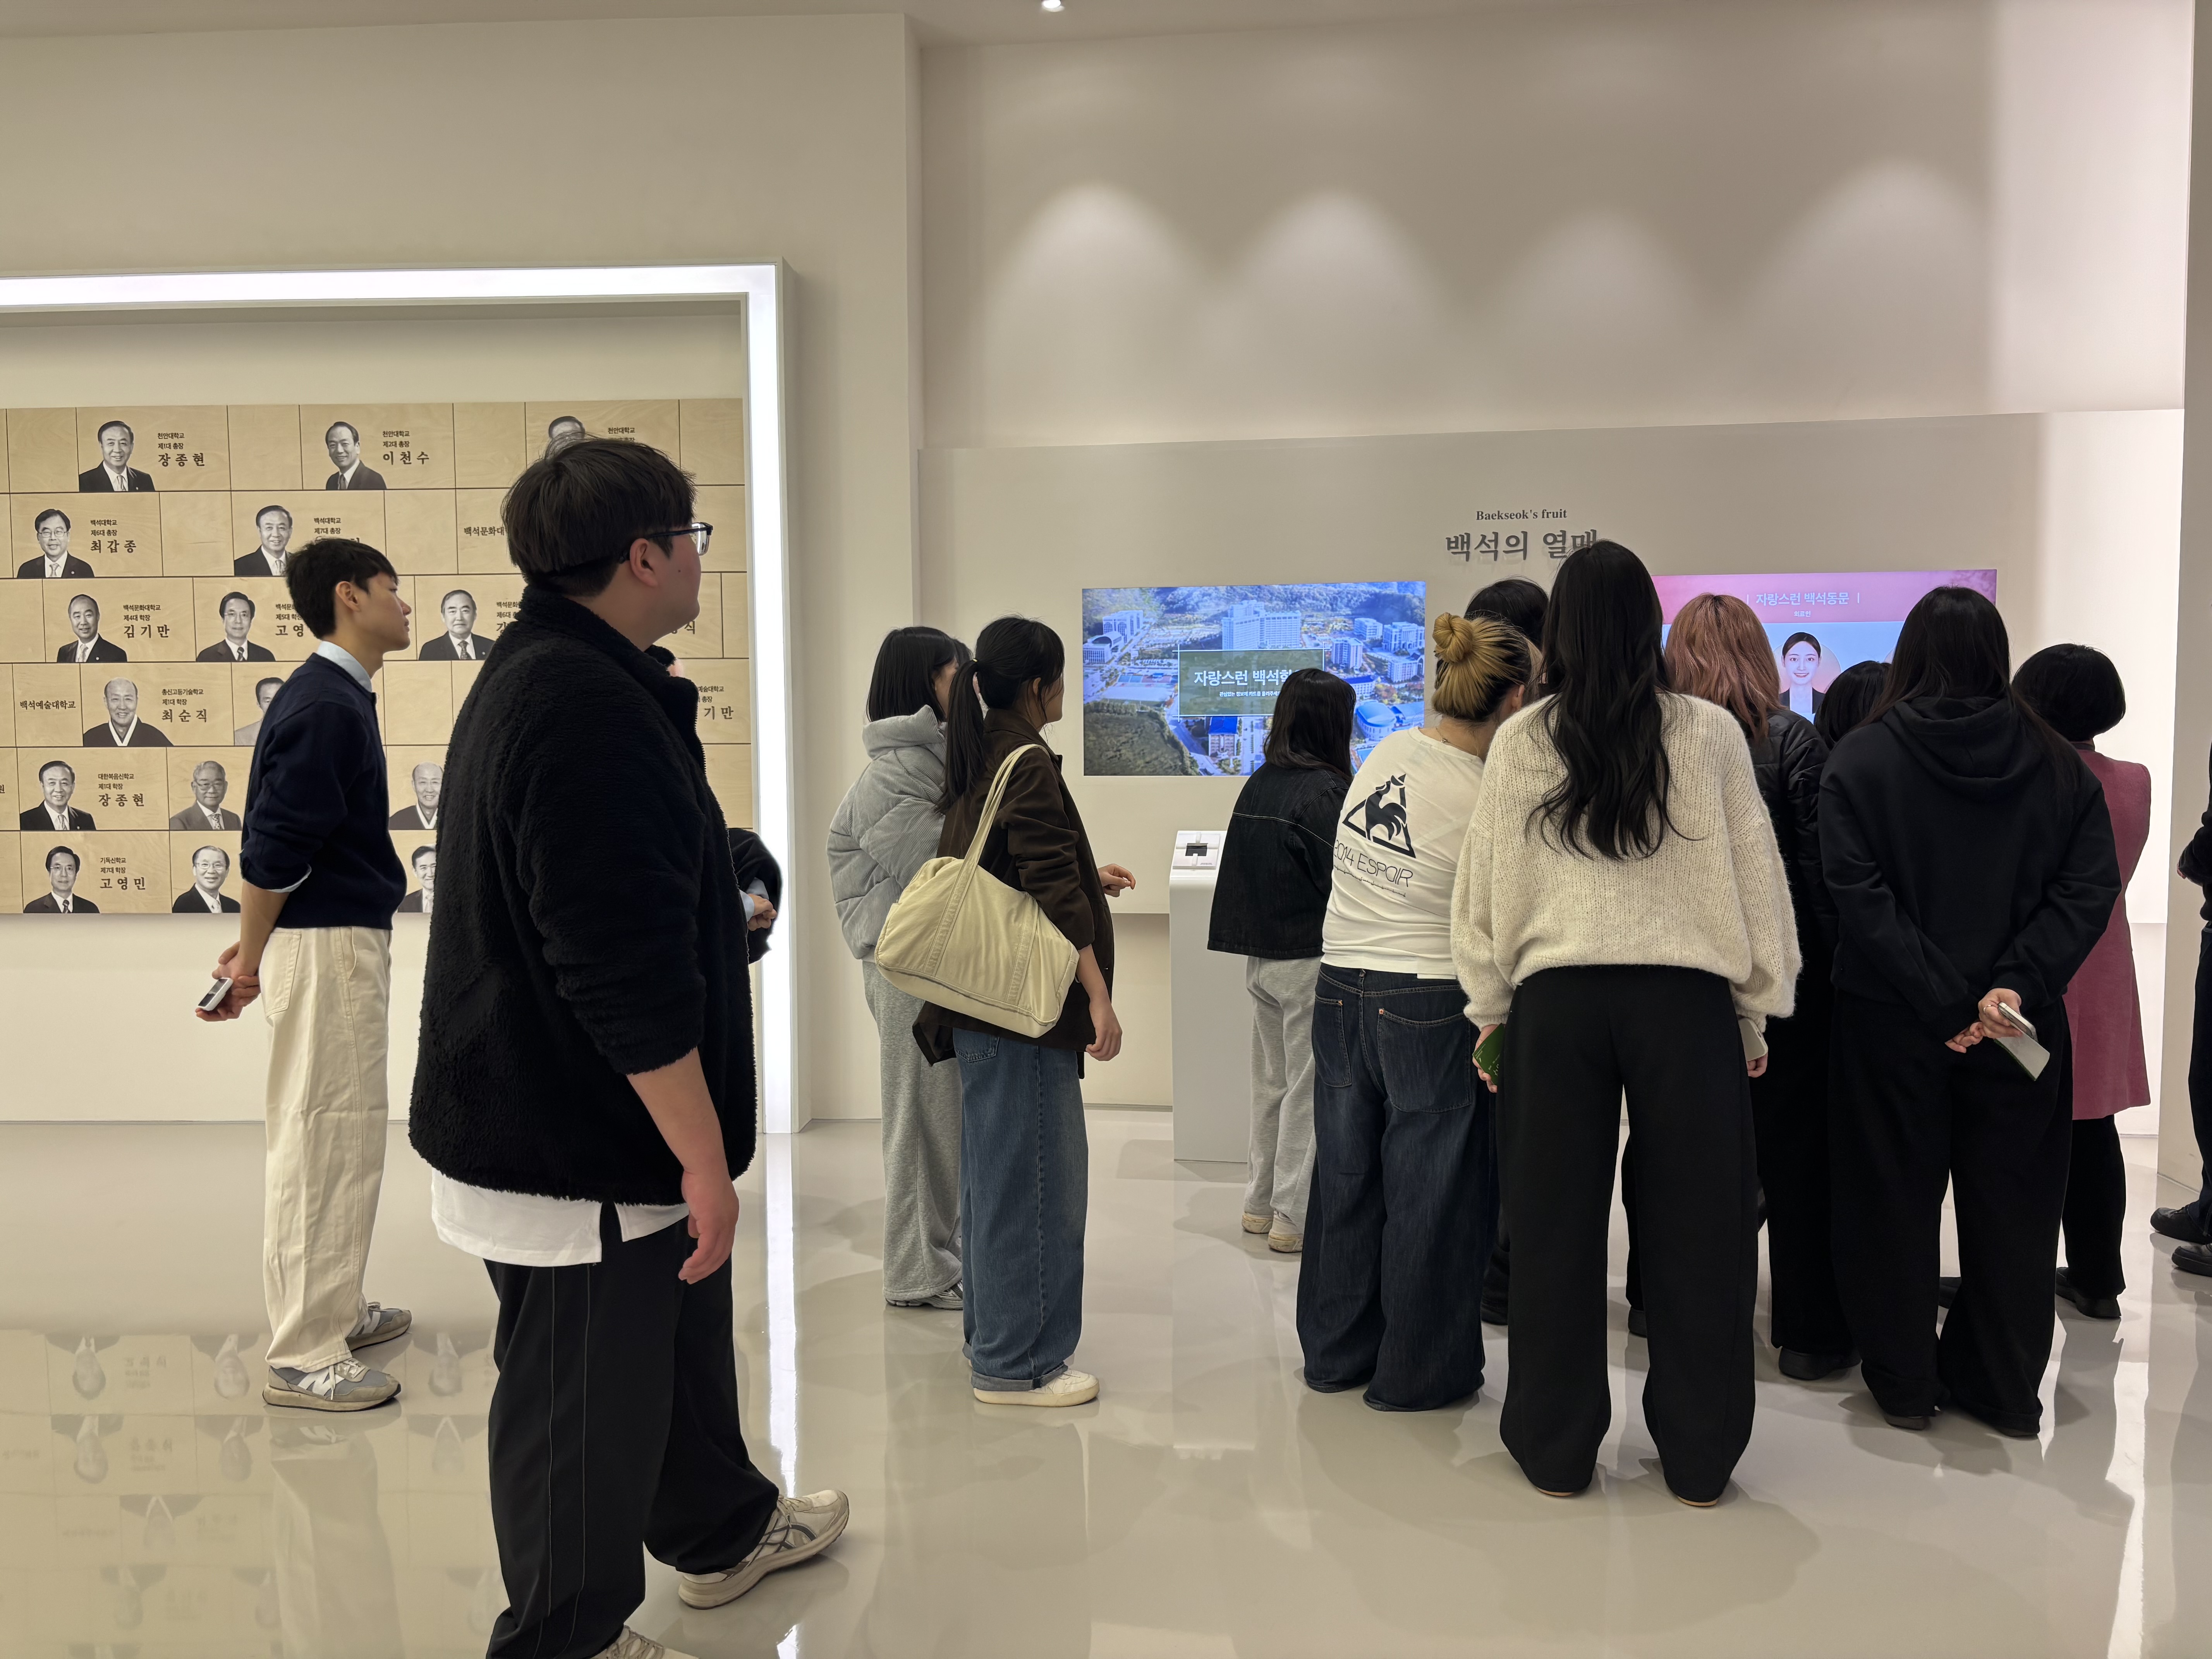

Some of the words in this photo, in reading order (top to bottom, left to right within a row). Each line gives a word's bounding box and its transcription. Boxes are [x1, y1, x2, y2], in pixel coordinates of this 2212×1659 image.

[1476, 509, 1538, 521] Baekseok's
[1541, 508, 1568, 519] fruit
[464, 526, 505, 537] 백석문화대
[1445, 531, 1529, 562] 백석의
[1755, 592, 1801, 606] 자랑스런
[1804, 592, 1850, 605] 백석동문
[1194, 670, 1248, 687] 자랑스런
[20, 700, 77, 710] 백석예술대학교
[1357, 852, 1413, 888] ESPOIR
